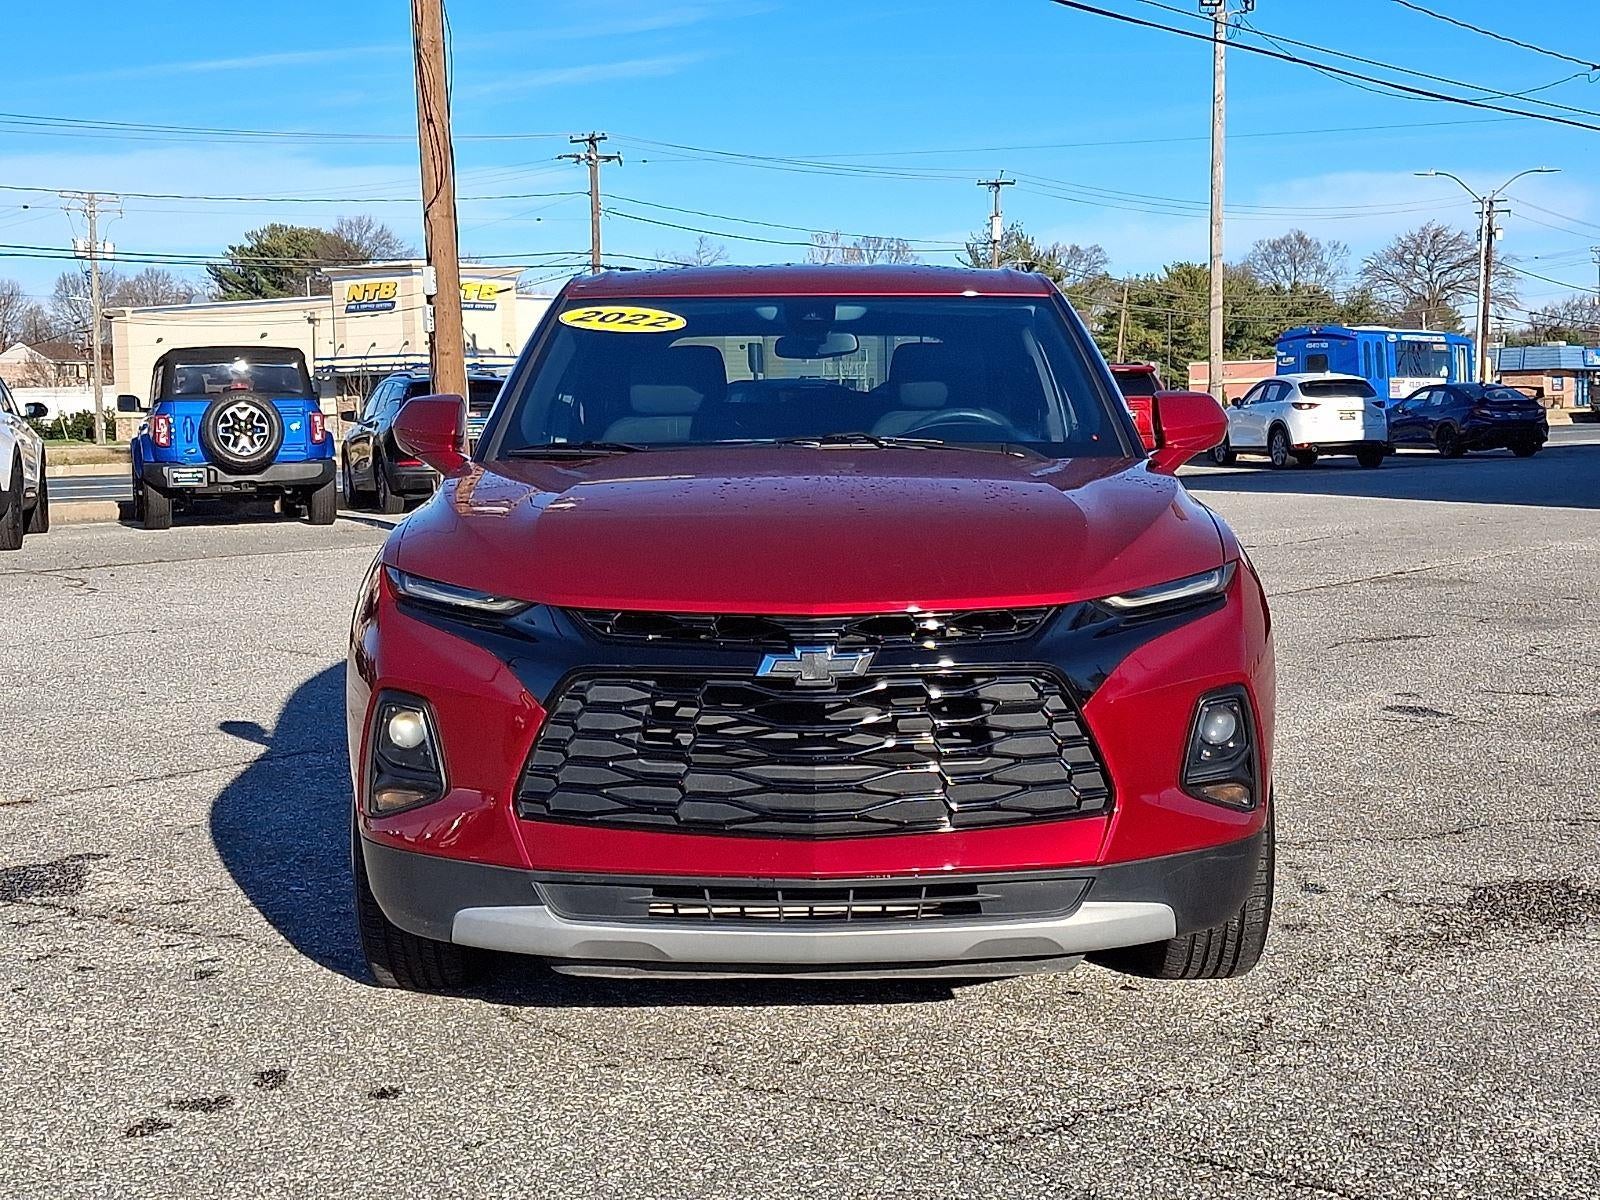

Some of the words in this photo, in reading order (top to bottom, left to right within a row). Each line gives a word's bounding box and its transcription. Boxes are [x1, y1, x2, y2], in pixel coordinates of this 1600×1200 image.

[347, 282, 397, 302] NTB
[460, 282, 498, 301] TB
[570, 310, 677, 328] 2022
